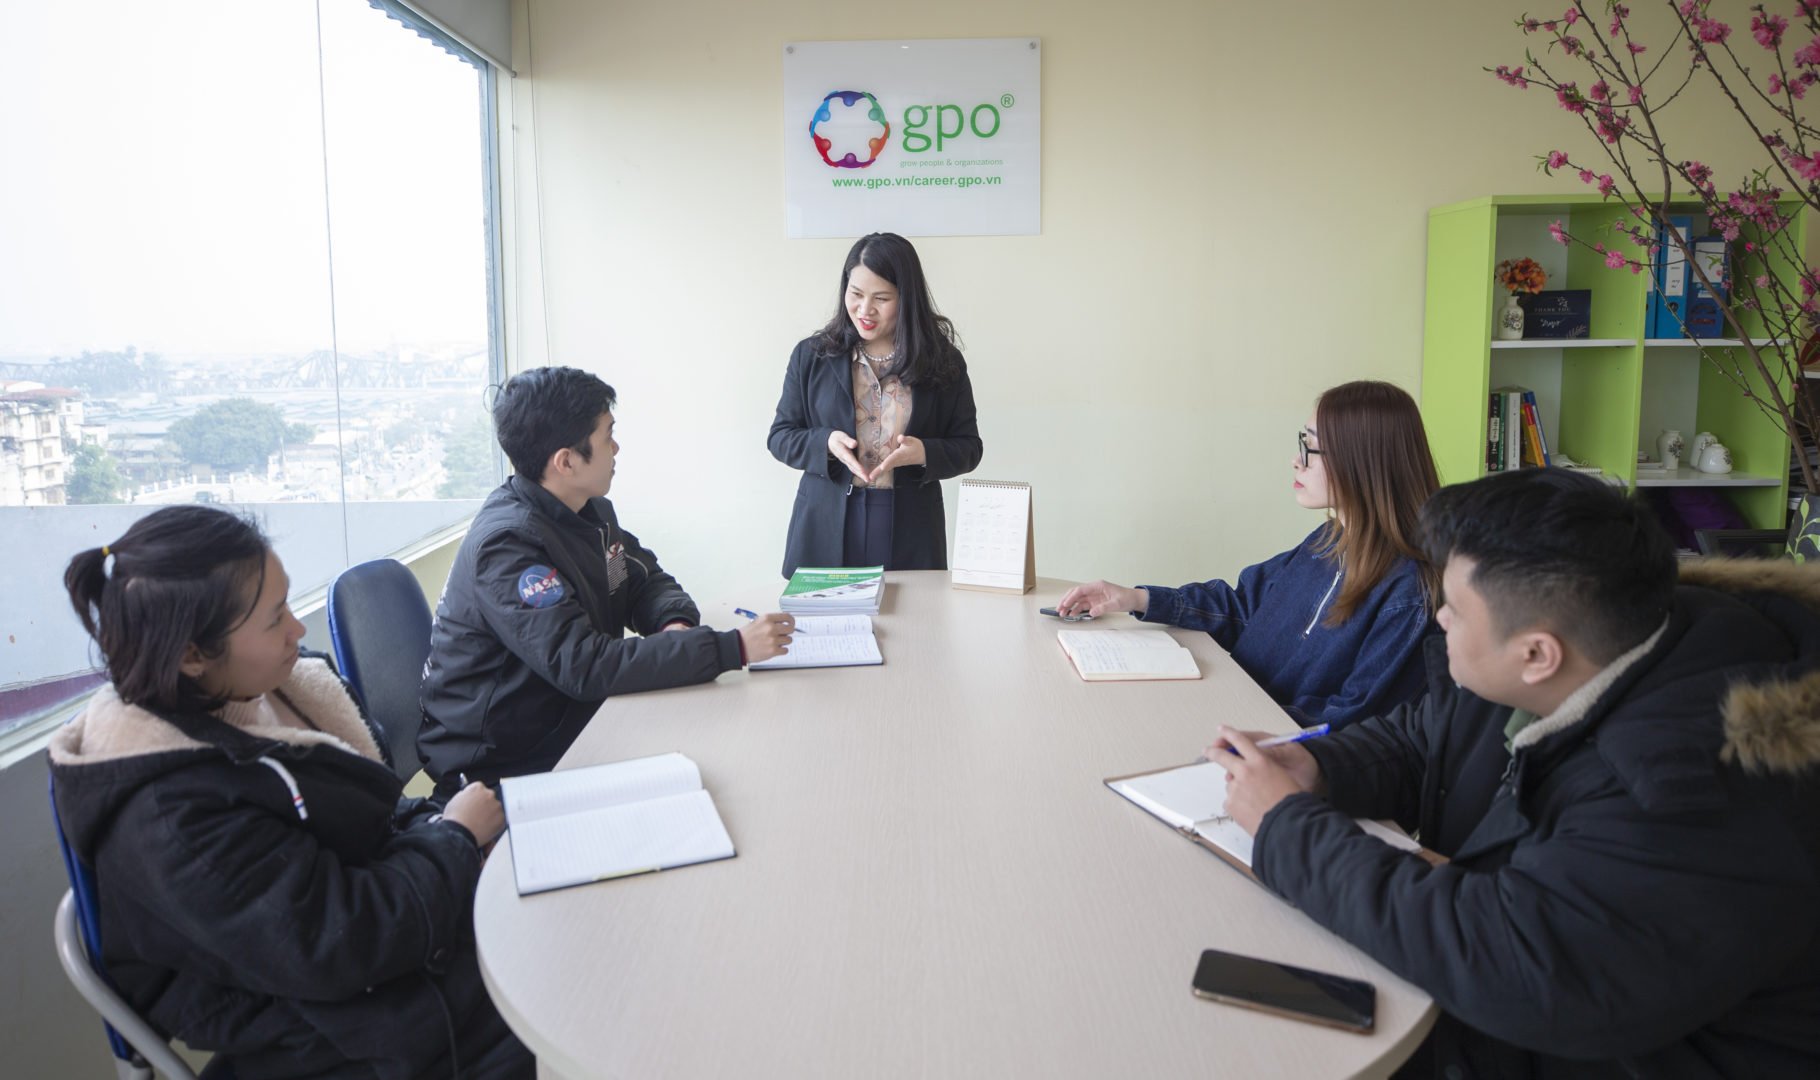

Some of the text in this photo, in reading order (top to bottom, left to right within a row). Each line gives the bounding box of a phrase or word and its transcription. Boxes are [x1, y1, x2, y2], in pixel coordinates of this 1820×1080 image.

[900, 158, 1004, 168] grow people & organizations
[832, 175, 1003, 190] www.gpo.vn/career.gpo.vn
[522, 577, 561, 598] NASA
